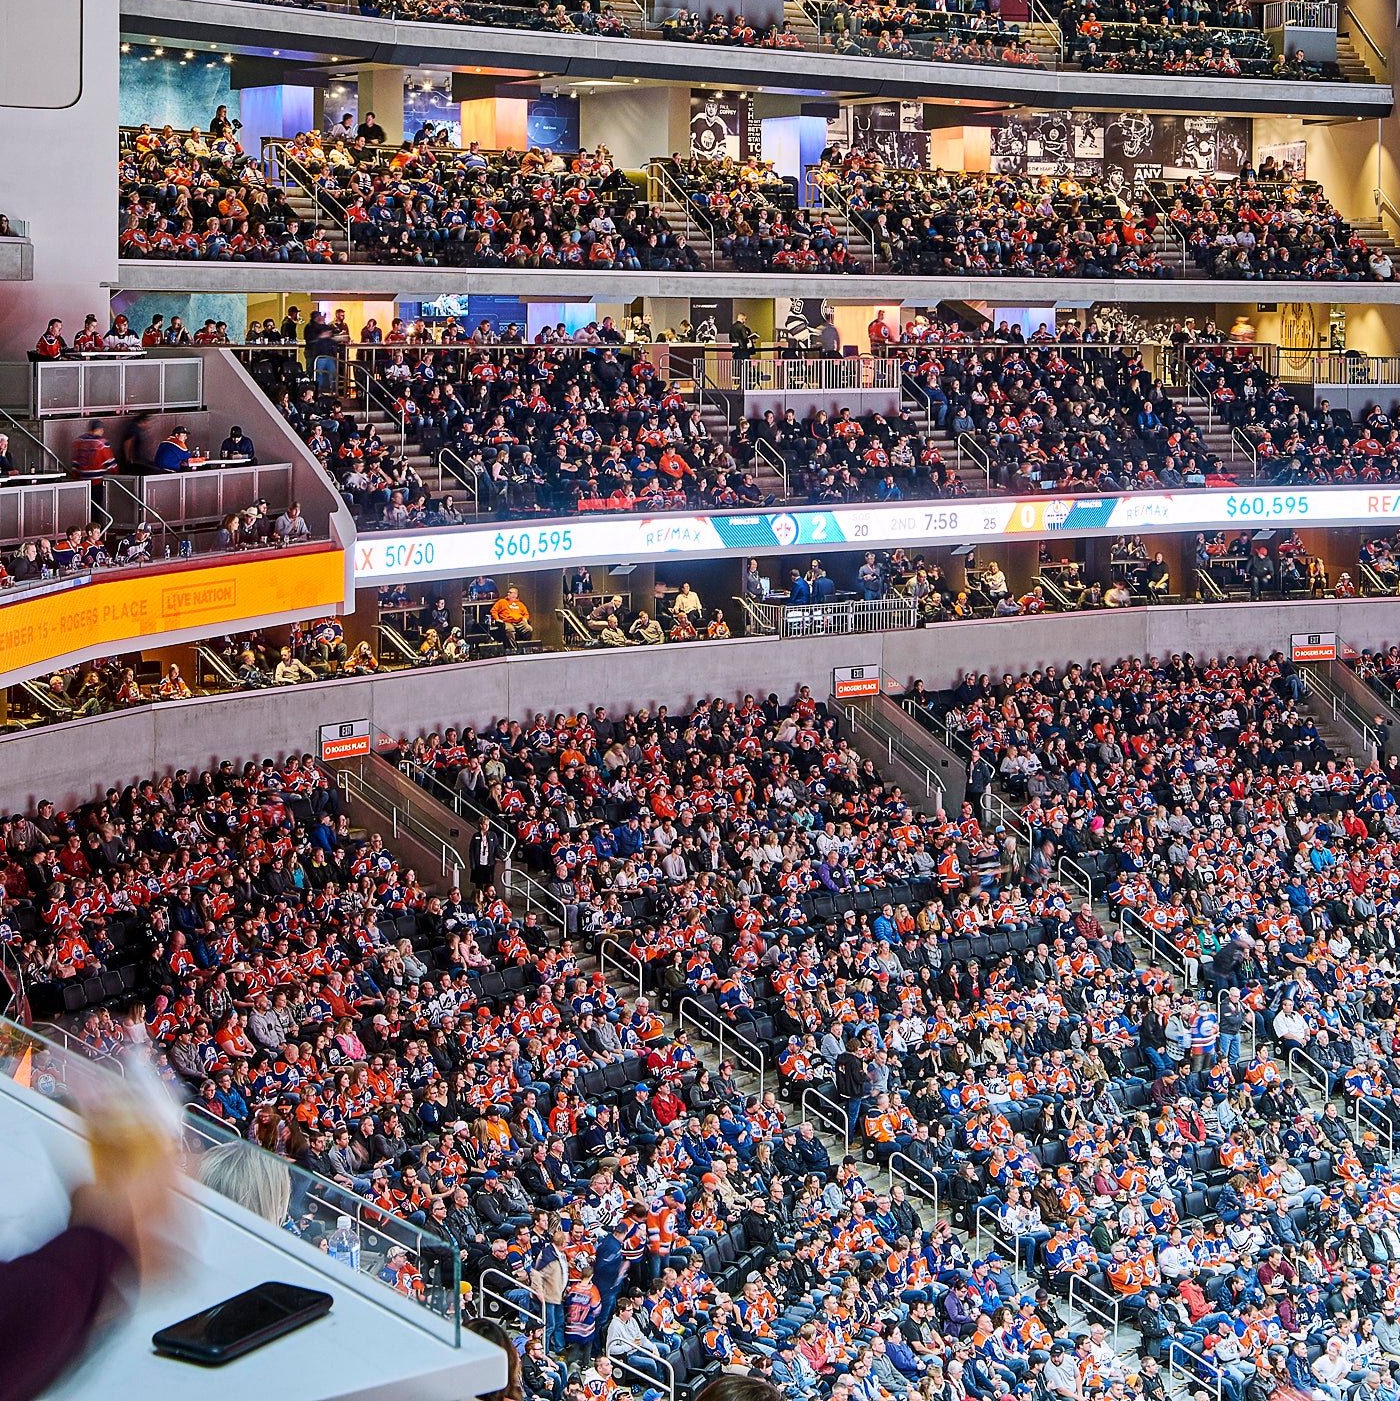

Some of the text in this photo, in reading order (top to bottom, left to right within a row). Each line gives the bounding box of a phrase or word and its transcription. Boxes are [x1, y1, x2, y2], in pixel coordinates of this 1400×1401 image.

[1134, 168, 1163, 179] ANY
[1126, 504, 1169, 521] RE/MAX
[1226, 495, 1309, 518] $60,595
[891, 512, 958, 531] 2ND 7:58
[983, 517, 997, 530] 25
[1020, 505, 1036, 529] 0
[646, 526, 701, 546] RE/MAX
[811, 515, 827, 540] 2
[854, 524, 869, 537] 20
[494, 530, 573, 560] $60,595
[166, 586, 233, 610] LIVE NATION
[38, 625, 49, 639] 15
[60, 607, 98, 634] ROGERS
[103, 599, 148, 622] PLACE
[331, 741, 367, 753] ROGERS PLACE
